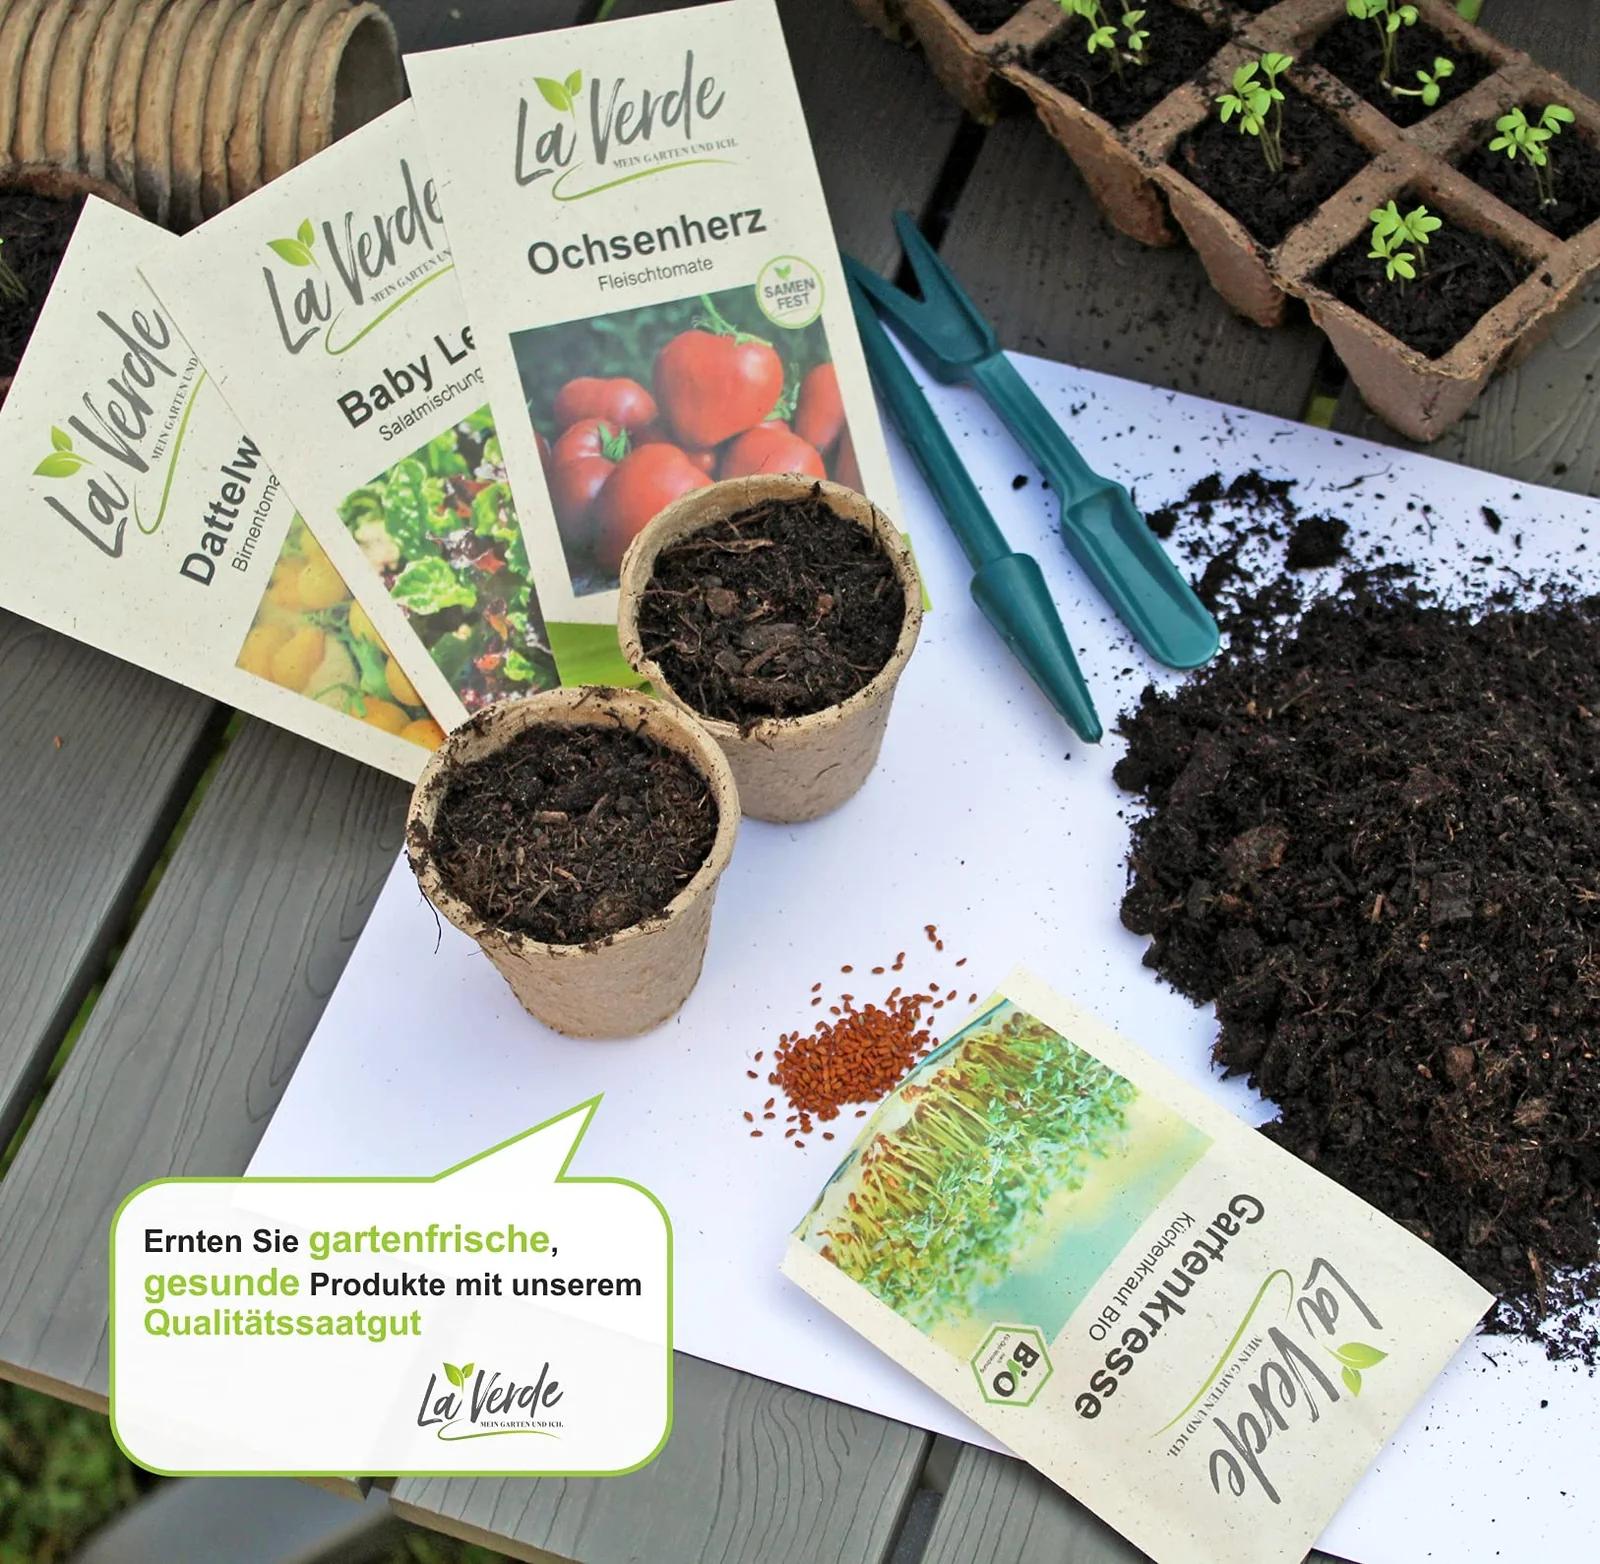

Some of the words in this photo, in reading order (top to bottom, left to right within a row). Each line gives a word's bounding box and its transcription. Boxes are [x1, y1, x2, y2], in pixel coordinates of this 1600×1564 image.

[515, 97, 577, 186] La
[590, 49, 726, 165] Verde
[613, 156, 641, 168] MEIN
[643, 147, 689, 162] GARTEN
[690, 143, 714, 154] UND
[262, 266, 332, 354] La
[322, 158, 443, 305] Verde
[527, 208, 767, 275] Ochsenherz
[598, 256, 714, 291] Fleischtomate
[370, 283, 397, 304] MEIN
[397, 256, 437, 288] GARTEN
[764, 278, 816, 299] SAMEN
[777, 293, 811, 310] FEST
[68, 309, 177, 473] Verde
[152, 432, 169, 460] MEIN
[164, 382, 188, 430] GARTEN
[183, 356, 199, 381] UND
[337, 354, 434, 429] Baby
[44, 471, 129, 559] La
[179, 435, 261, 586] Dattelw
[1113, 1211, 1196, 1307] Küchenkraut
[1075, 1194, 1265, 1419] Gartenkresse
[1089, 1305, 1121, 1341] BIO
[1296, 1257, 1384, 1338] La
[1238, 1335, 1262, 1365] MEIN
[1186, 1409, 1208, 1434] UND
[1203, 1363, 1241, 1410] GARTEN
[1209, 1327, 1341, 1504] Verde
[1167, 1433, 1189, 1457] ICH.
